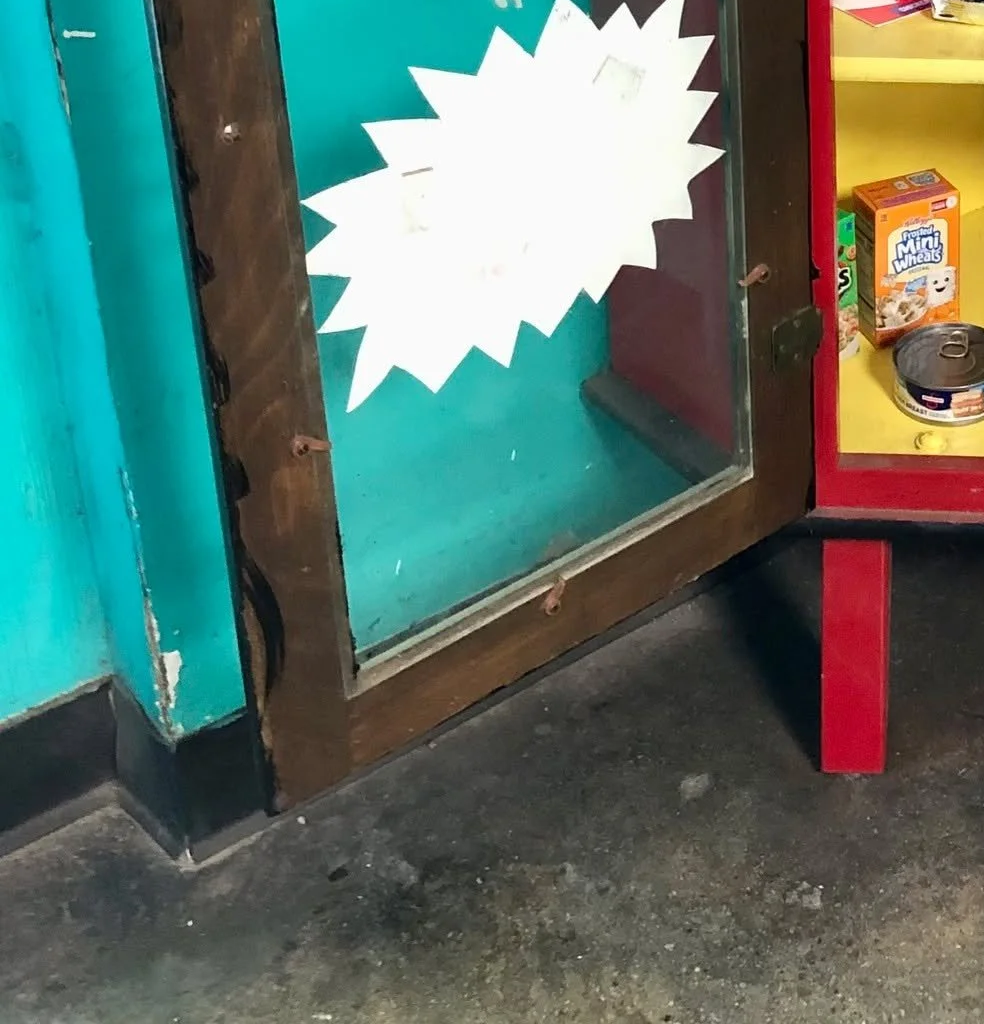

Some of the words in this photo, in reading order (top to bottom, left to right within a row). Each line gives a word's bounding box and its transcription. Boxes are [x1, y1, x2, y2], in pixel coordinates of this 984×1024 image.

[897, 232, 939, 259] Mini
[903, 226, 933, 241] Frosted
[893, 248, 941, 273] Wheats
